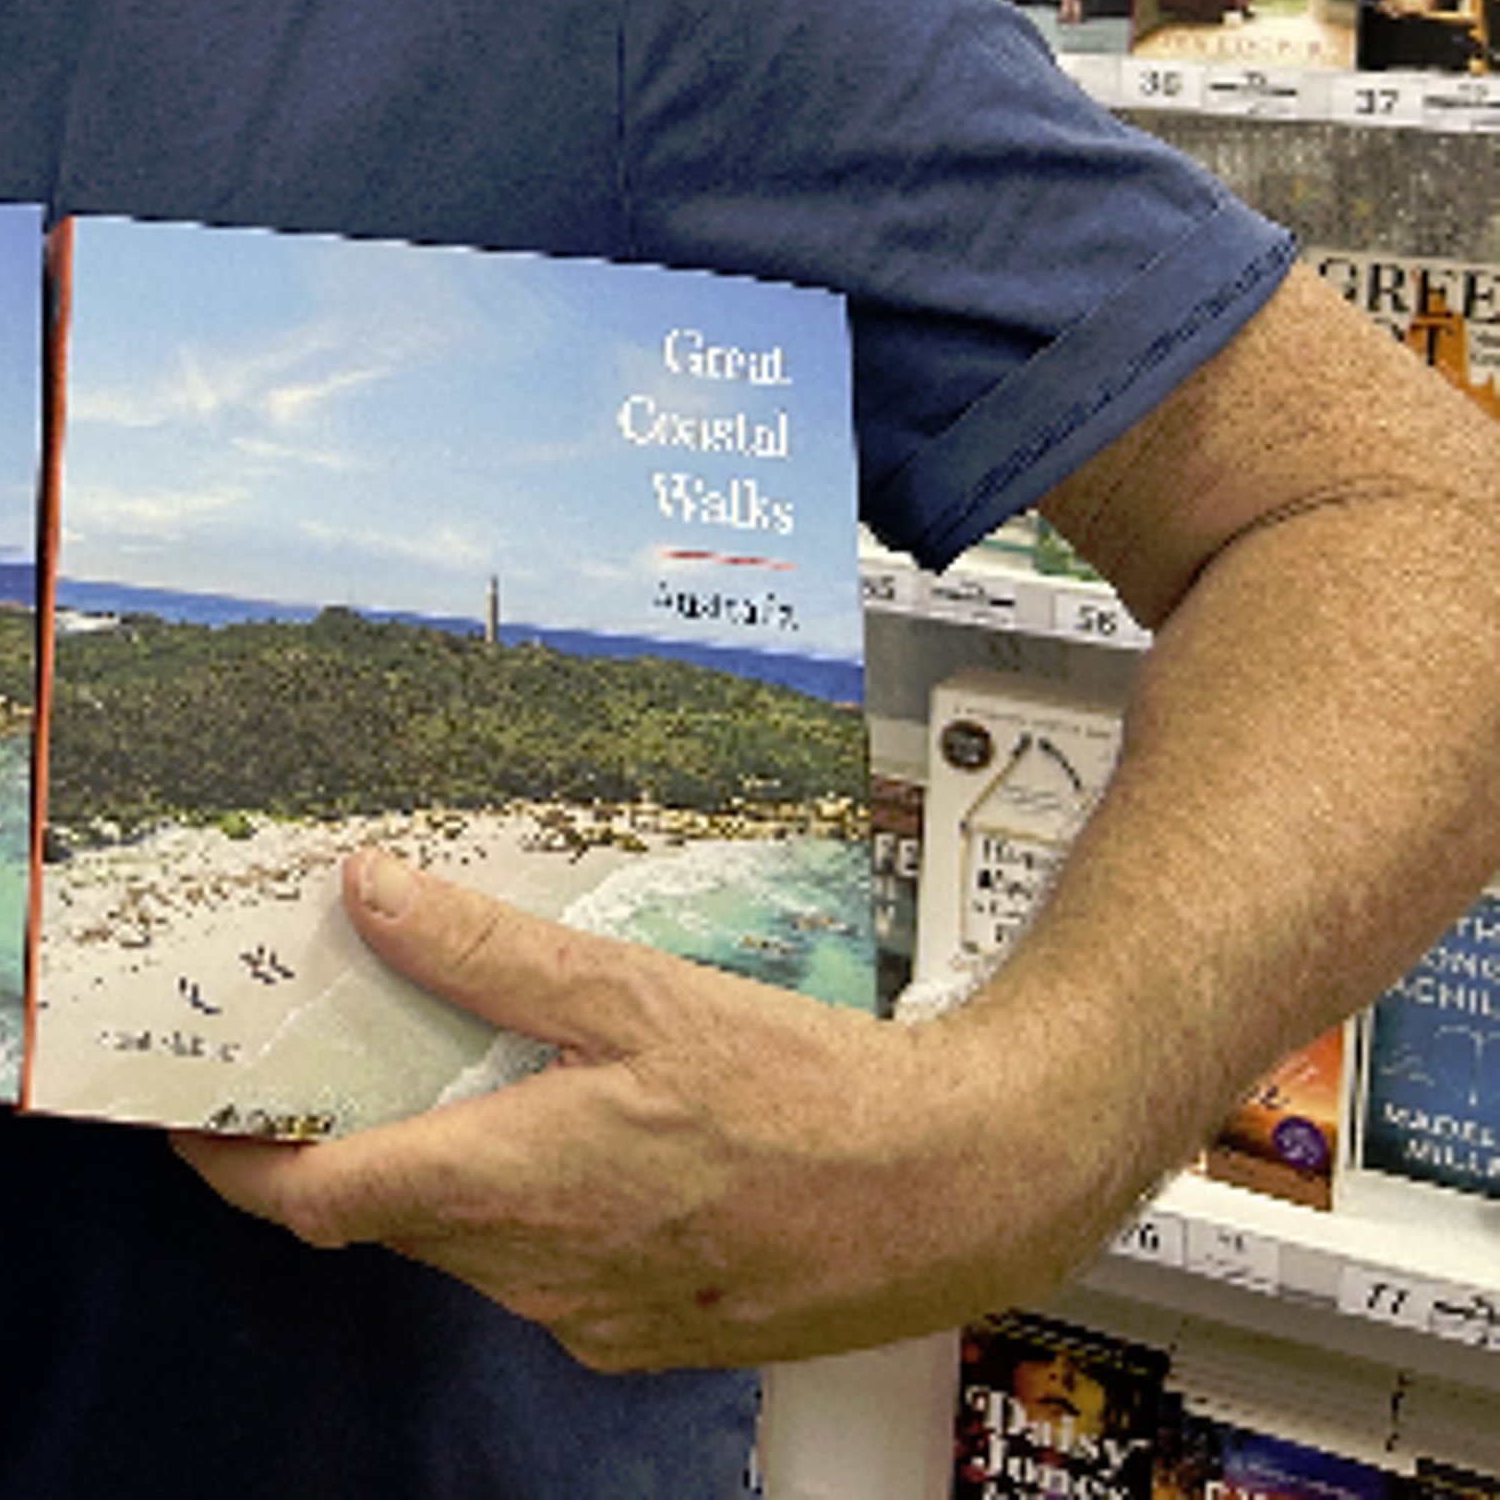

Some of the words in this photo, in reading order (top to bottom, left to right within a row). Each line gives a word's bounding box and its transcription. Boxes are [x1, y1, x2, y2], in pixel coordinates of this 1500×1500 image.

[1354, 87, 1399, 115] 37
[1317, 256, 1500, 324] GREE
[661, 327, 794, 386] Great
[616, 394, 788, 459] Coastal
[650, 471, 794, 535] Walks
[1384, 976, 1500, 1020] ACHIL
[965, 1384, 1152, 1462] Daisy
